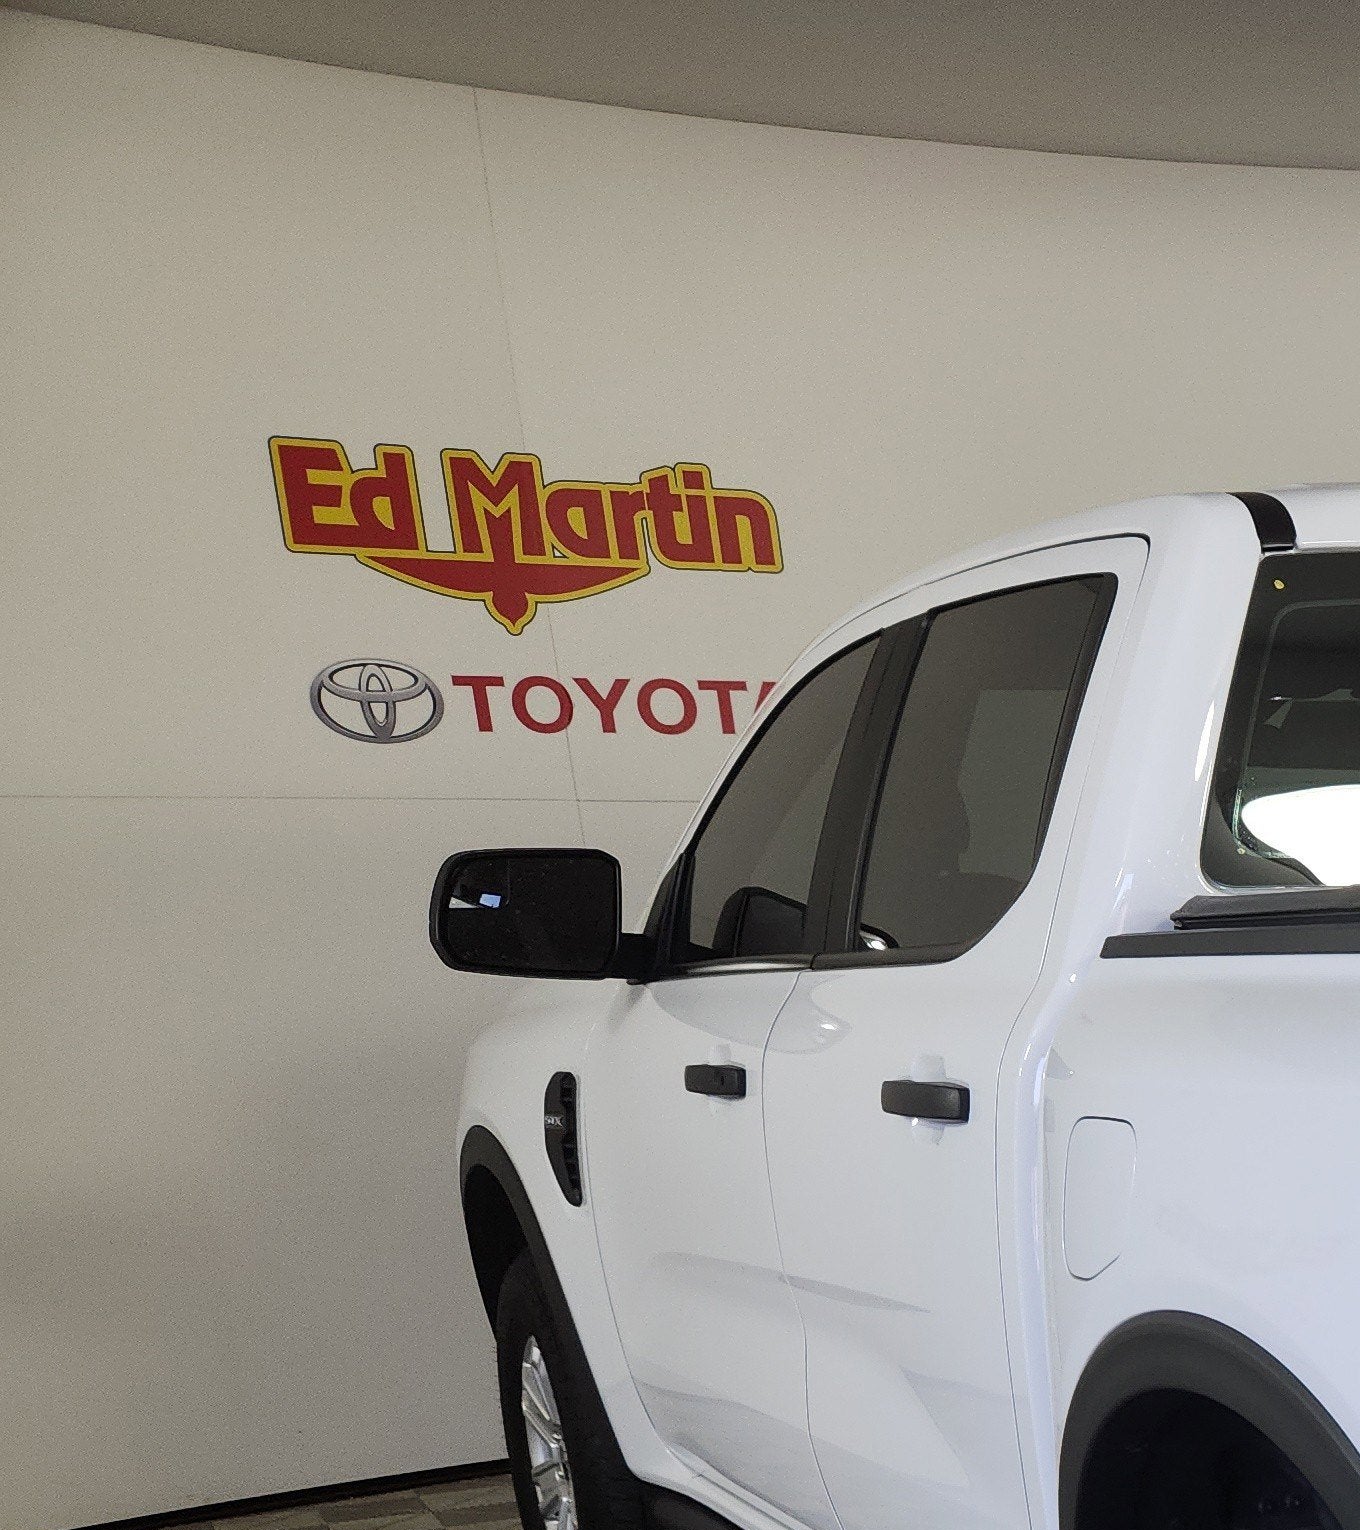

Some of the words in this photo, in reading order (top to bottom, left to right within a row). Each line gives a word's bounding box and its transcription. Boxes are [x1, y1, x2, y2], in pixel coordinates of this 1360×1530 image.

[272, 439, 425, 553] Ed
[443, 450, 782, 571] Martin
[451, 674, 777, 736] TOYOT
